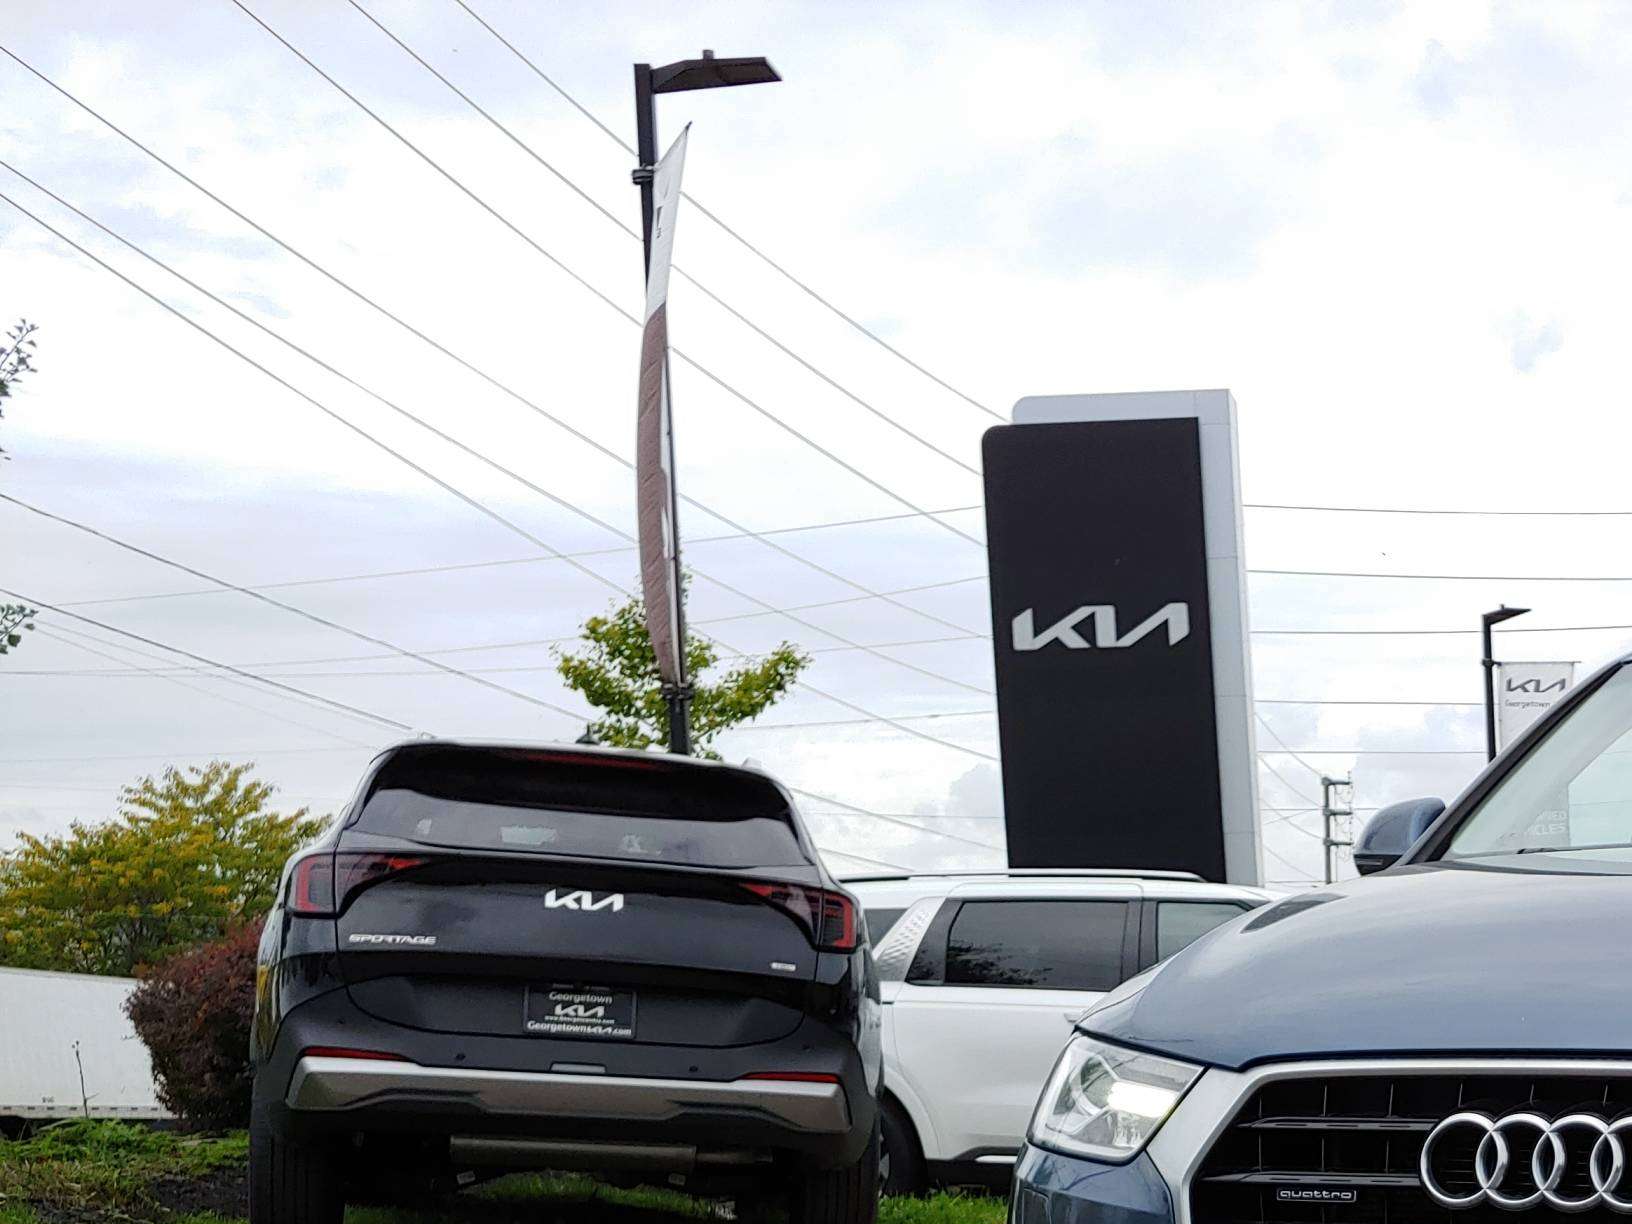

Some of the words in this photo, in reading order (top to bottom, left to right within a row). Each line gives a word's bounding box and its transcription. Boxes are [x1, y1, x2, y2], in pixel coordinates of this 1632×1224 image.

[1011, 602, 1190, 651] KIA
[1506, 678, 1566, 692] KIA
[545, 889, 624, 912] KIA
[349, 934, 437, 945] SPORTAGE
[549, 991, 613, 1004] Georgetown
[555, 1003, 605, 1017] KIA
[1280, 1190, 1352, 1200] quattro
